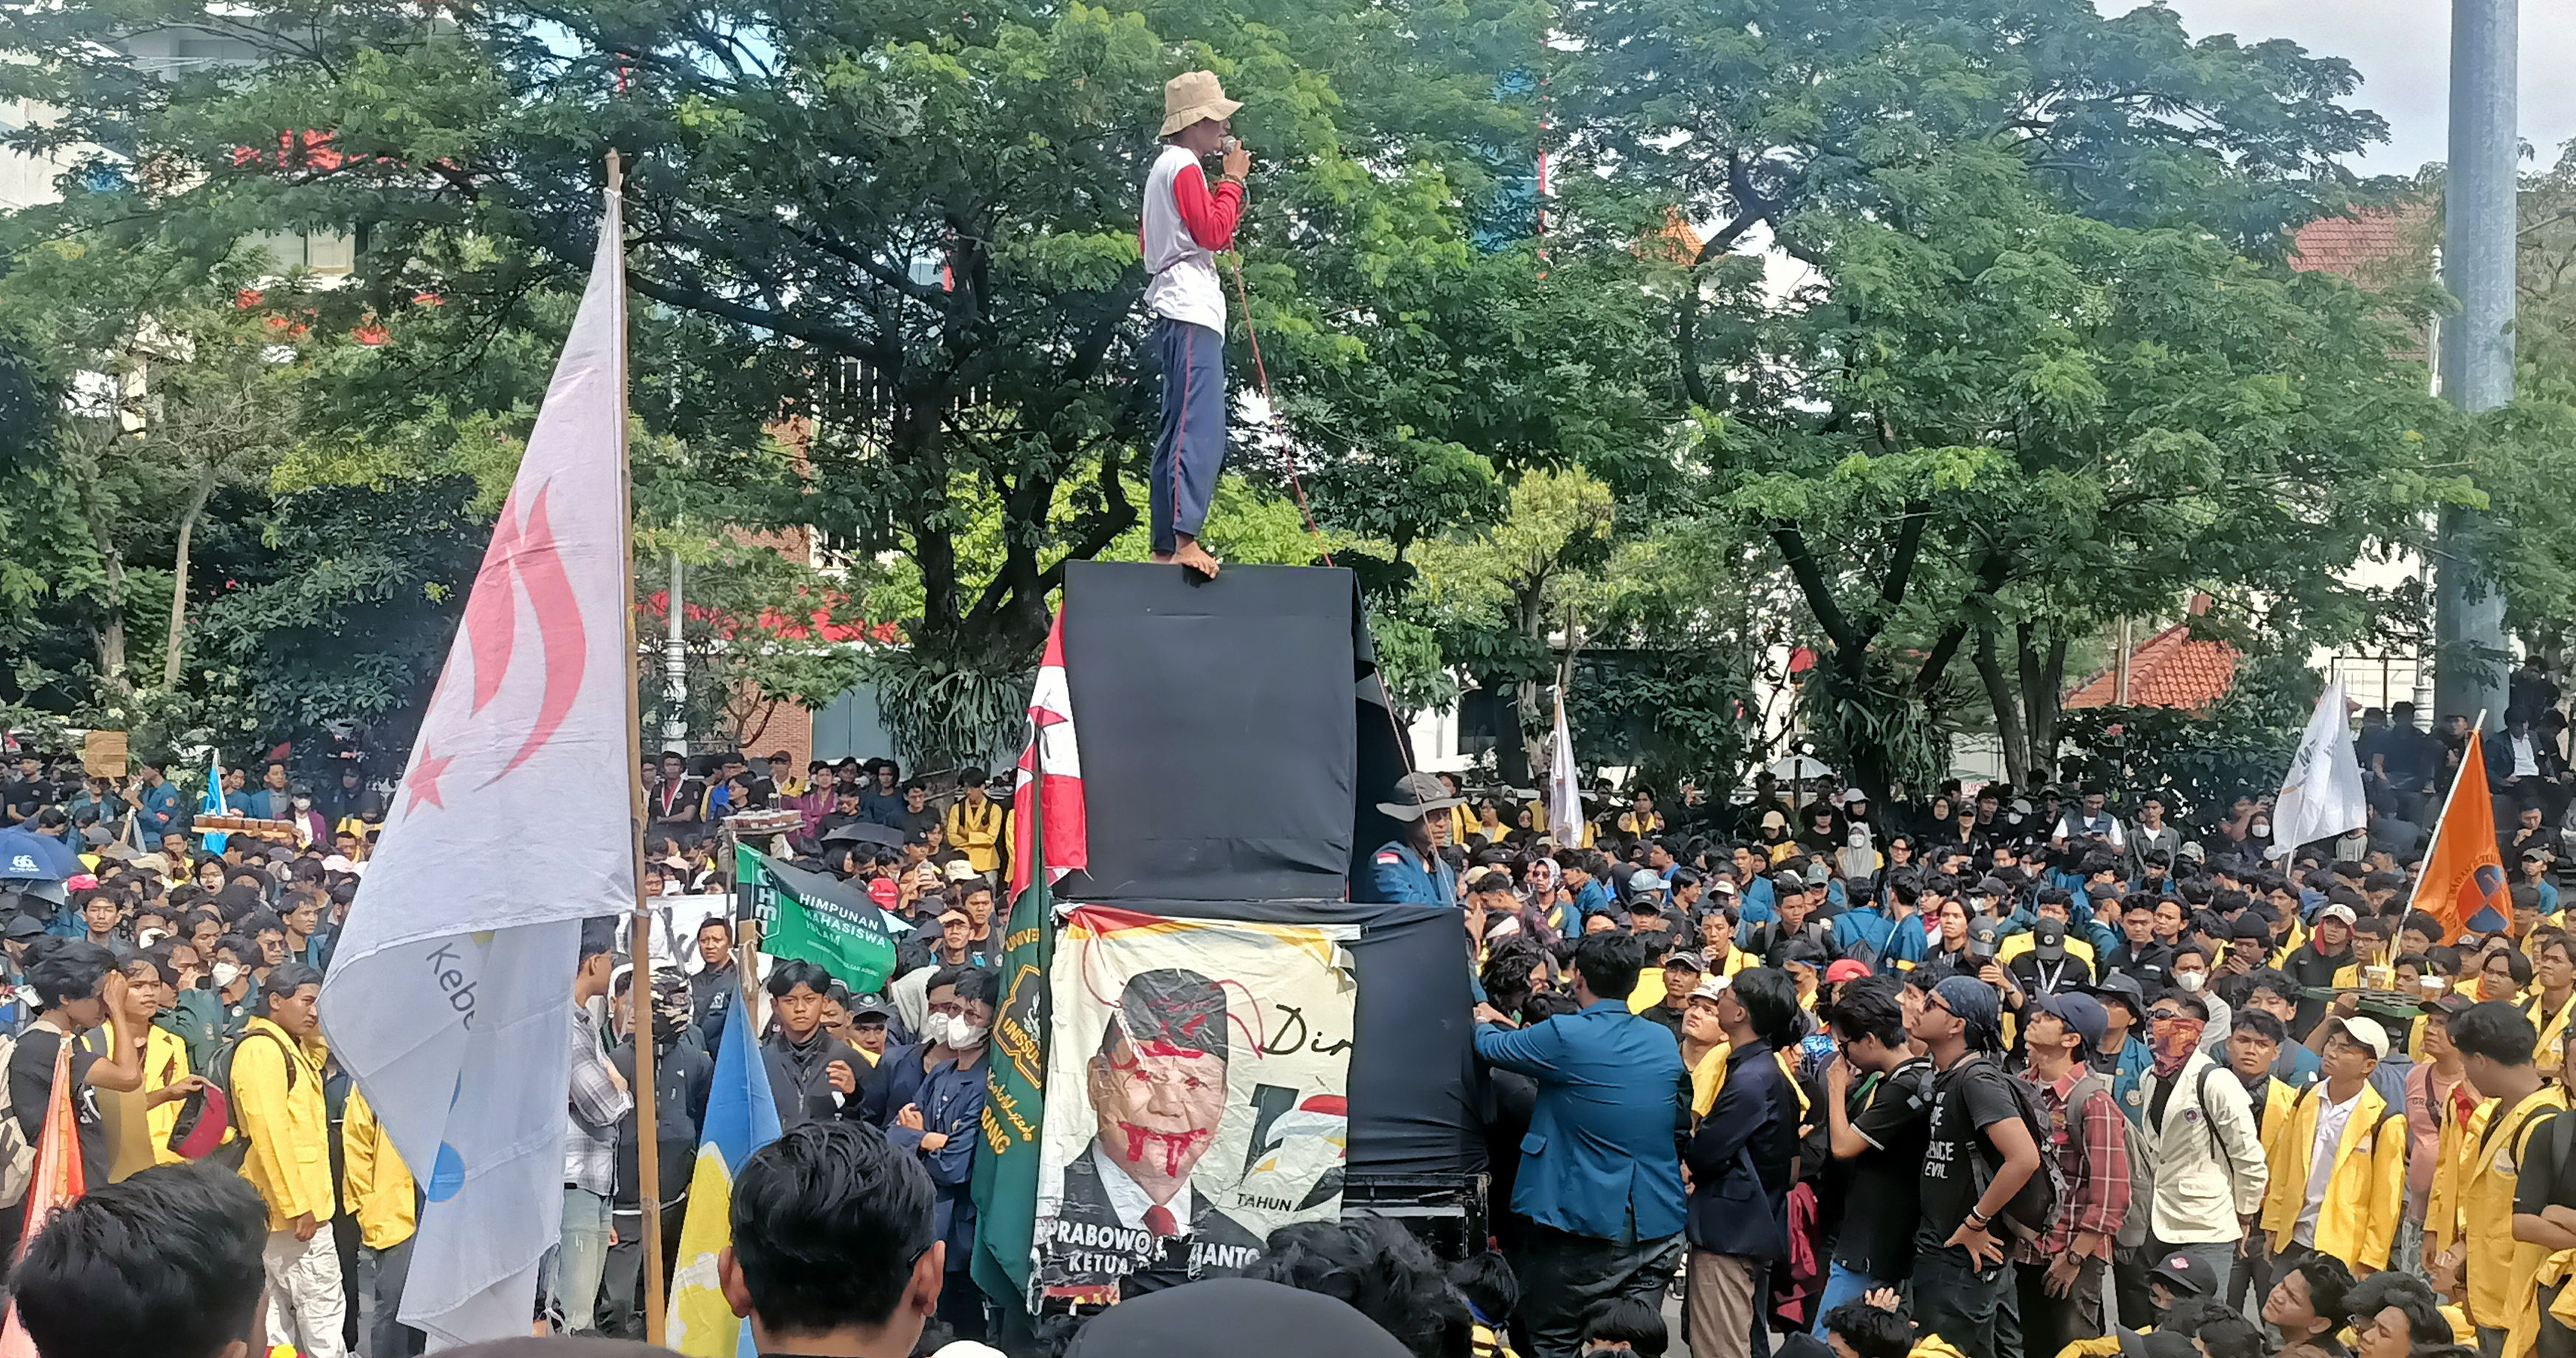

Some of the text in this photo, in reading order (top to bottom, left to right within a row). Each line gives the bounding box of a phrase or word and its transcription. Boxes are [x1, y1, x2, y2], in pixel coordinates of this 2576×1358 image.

[799, 892, 878, 931] HIMPUNAN
[802, 907, 886, 948] MAHASISWA
[805, 920, 841, 946] ISLAM
[1005, 928, 1040, 952] UNIVE
[1924, 1160, 1949, 1179] EVIL
[1237, 1193, 1292, 1213] TAHUN
[1048, 1219, 1151, 1255] PRABOWO
[1068, 1252, 1129, 1275] KETUA
